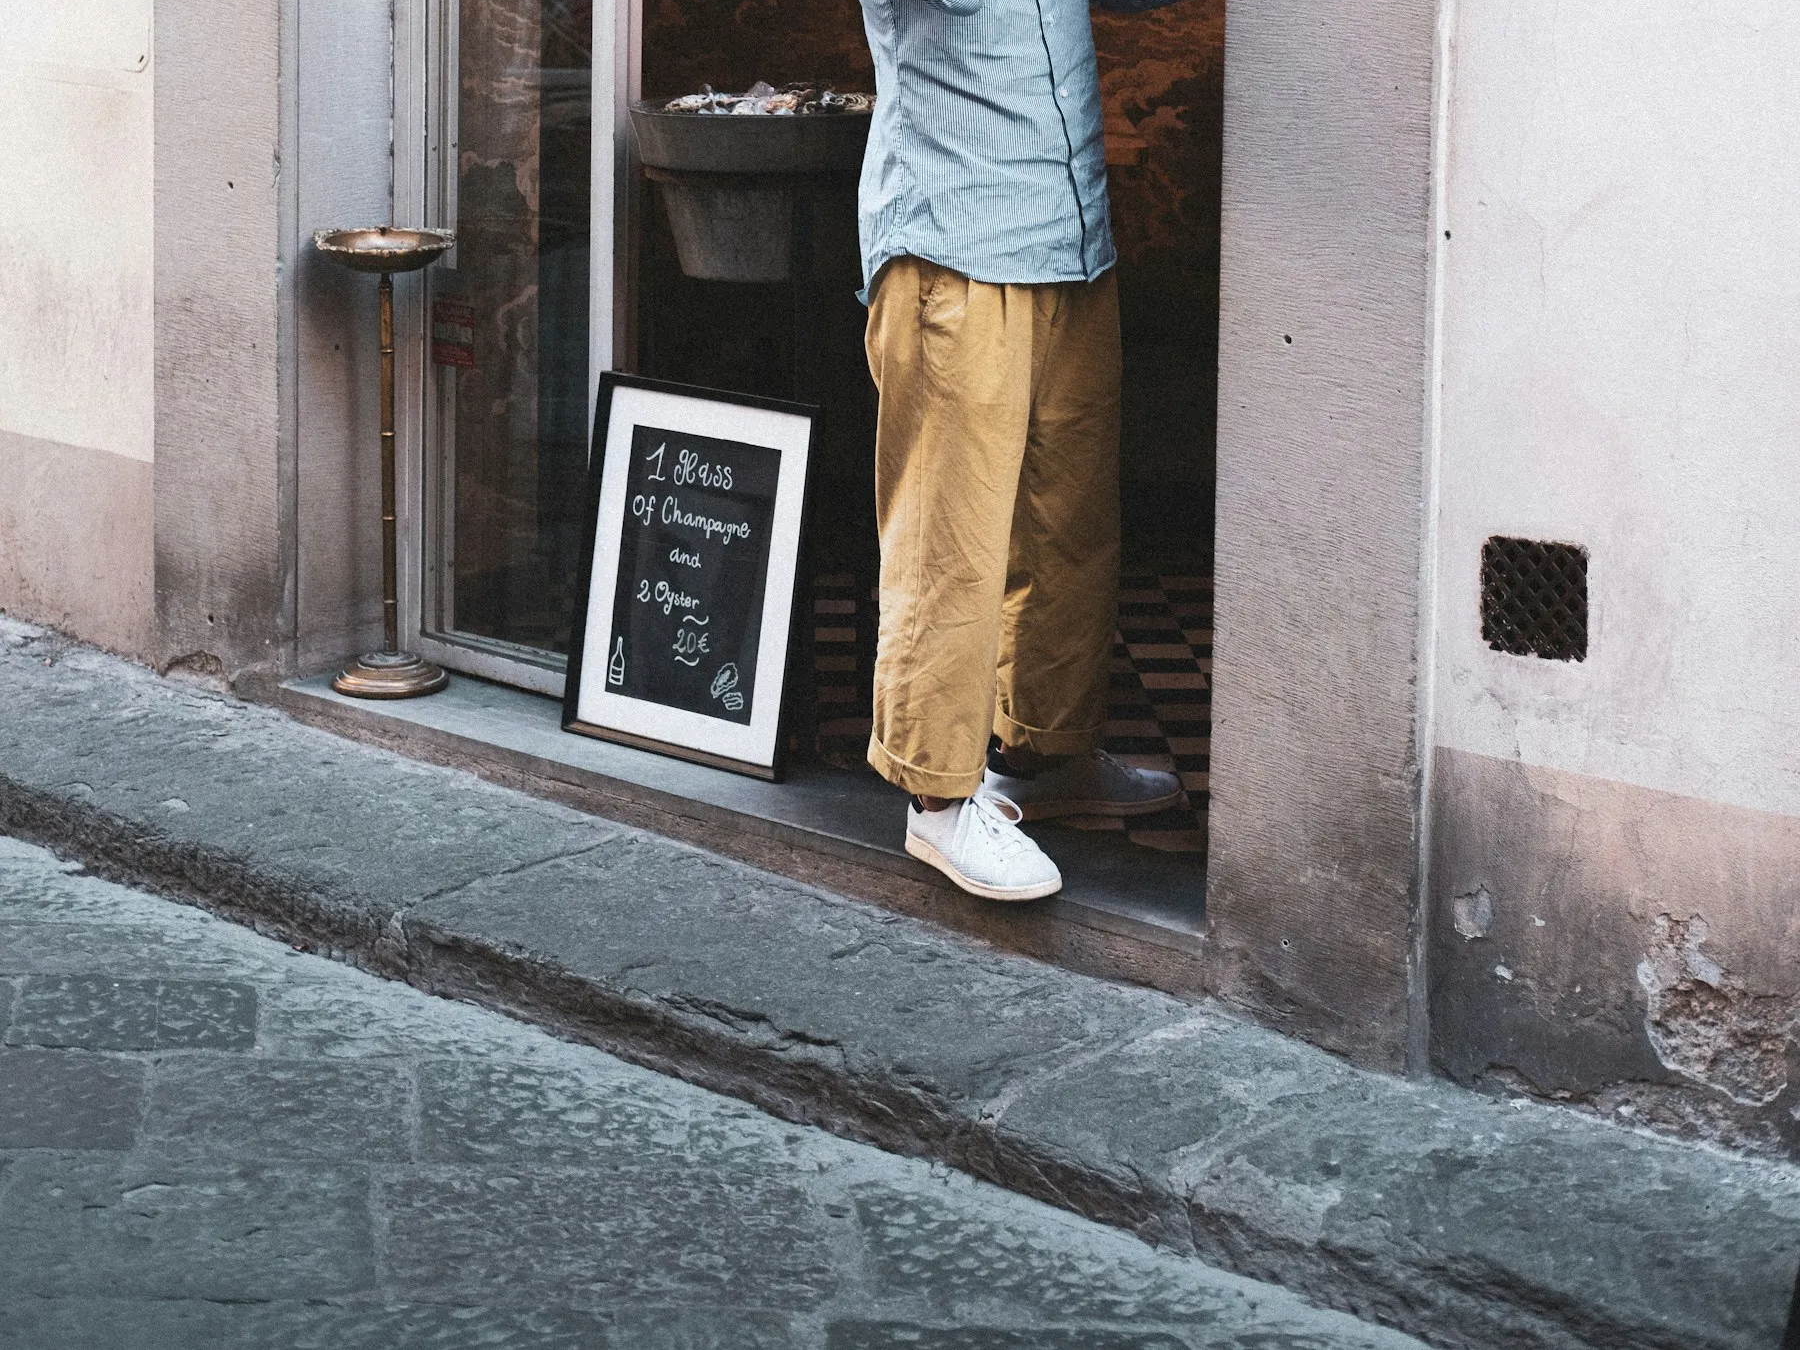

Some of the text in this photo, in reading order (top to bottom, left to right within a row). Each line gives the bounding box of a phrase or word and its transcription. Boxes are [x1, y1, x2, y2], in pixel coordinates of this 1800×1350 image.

[646, 442, 666, 481] 1
[632, 495, 751, 545] Of Champagne
[669, 547, 702, 568] and
[636, 579, 700, 615] 2 Oyster
[672, 629, 710, 654] 20€
